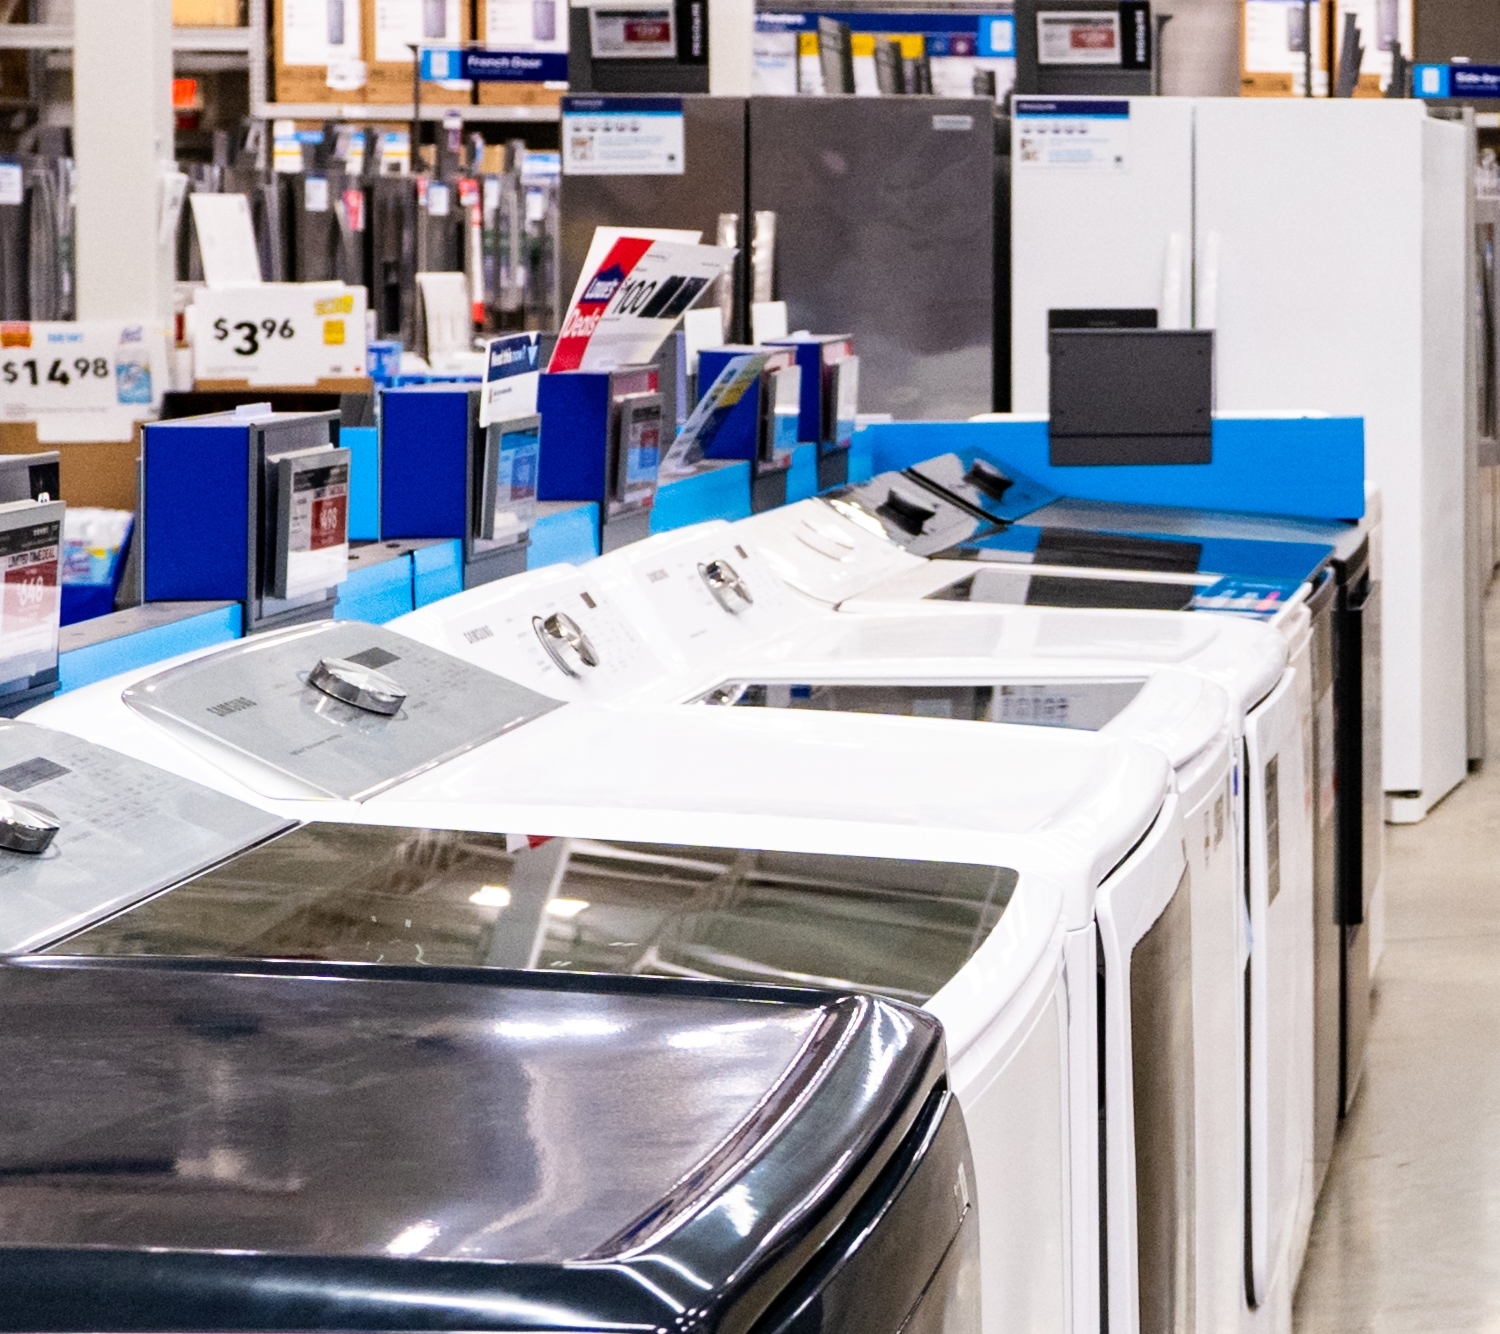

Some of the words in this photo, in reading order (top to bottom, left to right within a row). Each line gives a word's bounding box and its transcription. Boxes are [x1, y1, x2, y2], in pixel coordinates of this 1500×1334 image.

[467, 54, 508, 69] French
[511, 55, 543, 69] Door
[584, 277, 617, 300] Lowe's
[563, 307, 601, 339] Deals
[463, 624, 495, 645] SAMSUNG
[206, 695, 258, 718] SAMSUNG
